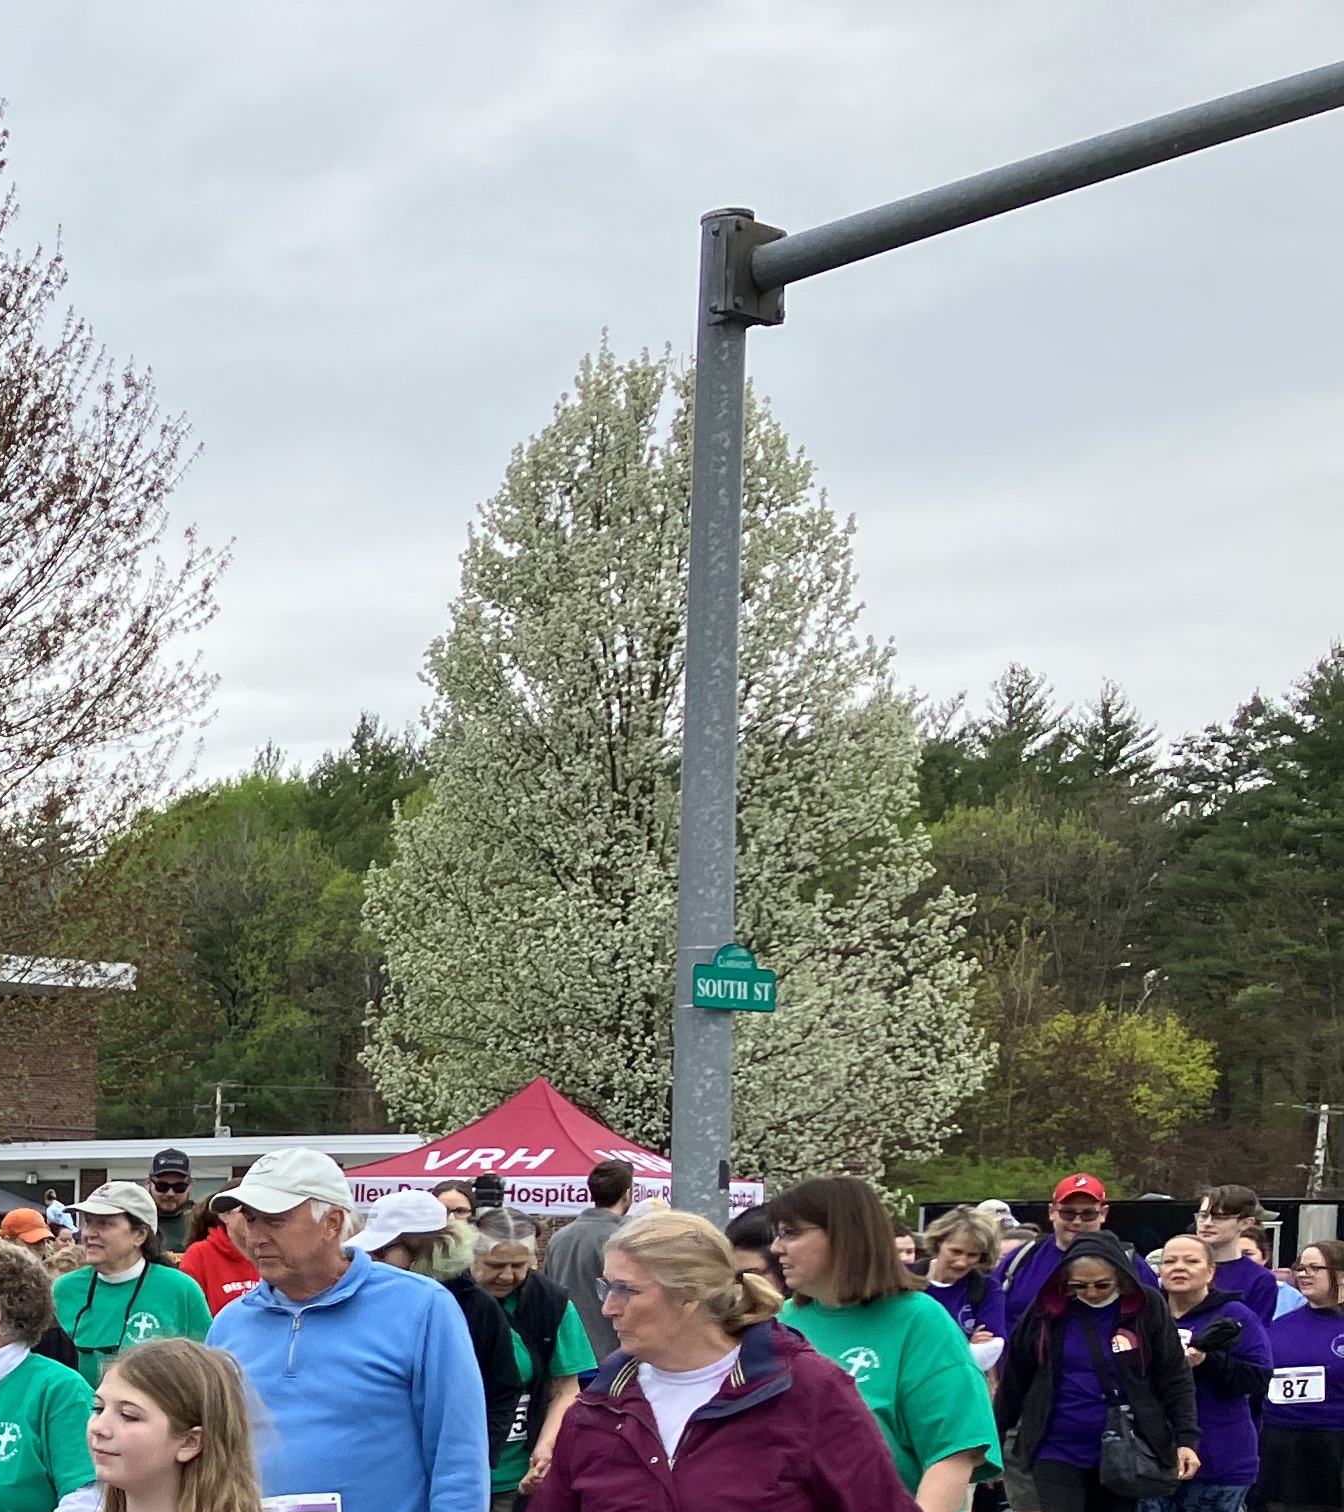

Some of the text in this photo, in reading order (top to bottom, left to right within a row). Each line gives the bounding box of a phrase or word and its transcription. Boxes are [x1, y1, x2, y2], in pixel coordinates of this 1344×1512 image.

[696, 977, 773, 1002] SOUTH ST
[423, 1148, 556, 1171] VRH
[1282, 1379, 1309, 1399] 87
